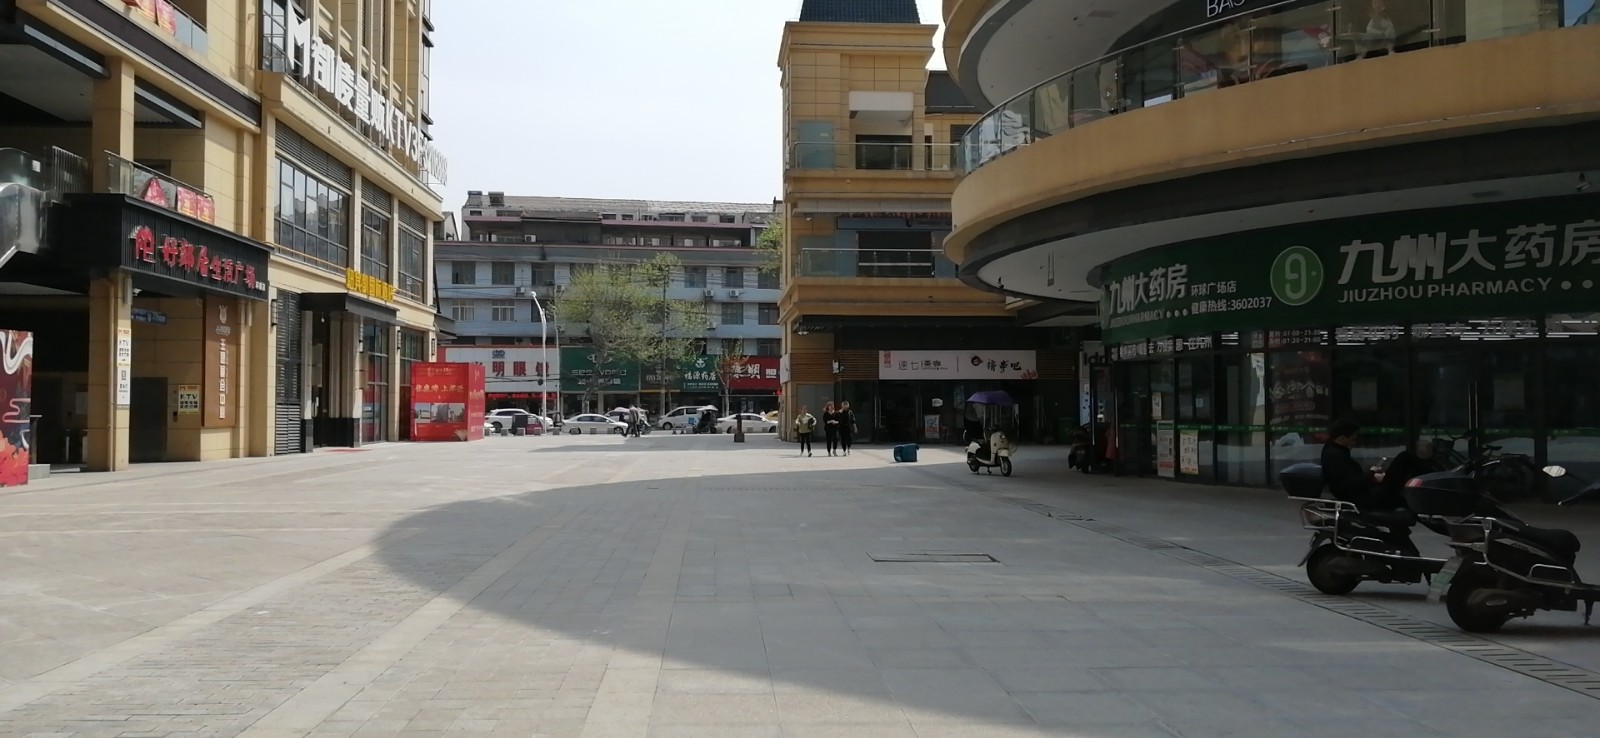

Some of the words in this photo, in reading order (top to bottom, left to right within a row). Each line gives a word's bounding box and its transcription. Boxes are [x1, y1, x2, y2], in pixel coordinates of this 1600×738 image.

[1337, 219, 1600, 285] 九州大药房
[1109, 263, 1188, 315] 九州大药房
[1190, 280, 1238, 297] 环球广场店
[1338, 285, 1423, 303] JIUZHOU
[1427, 277, 1552, 299] PHARMACY
